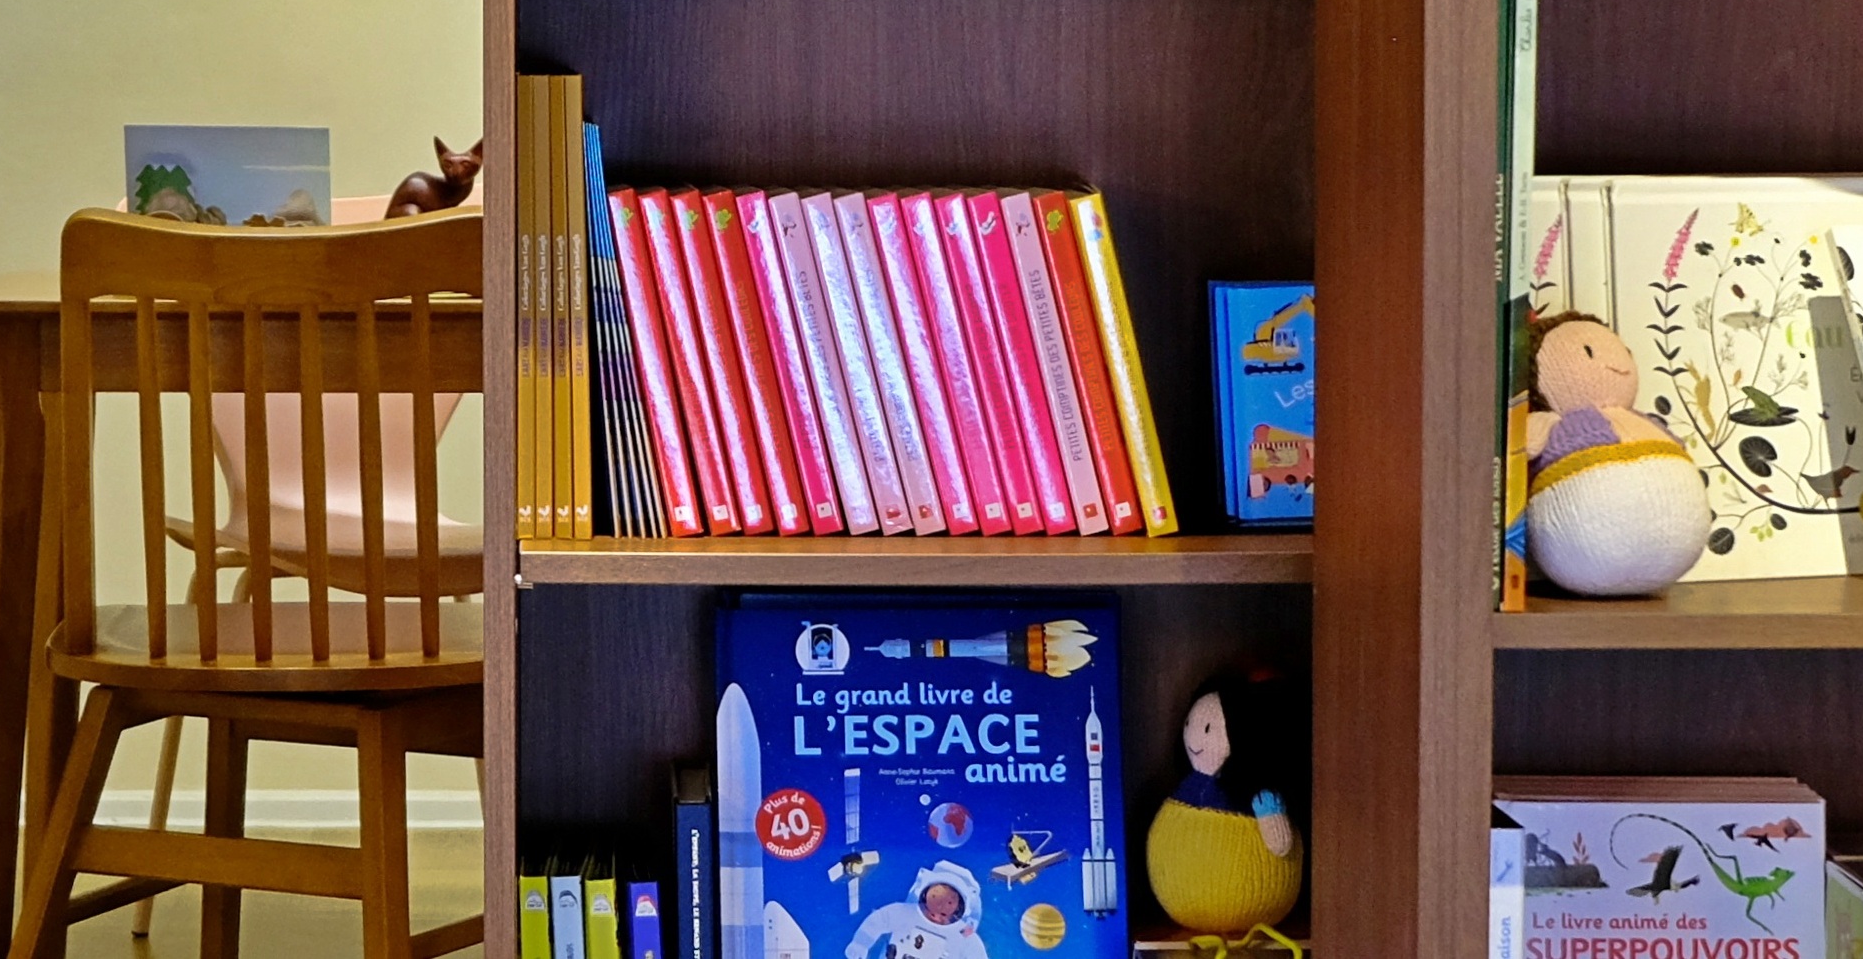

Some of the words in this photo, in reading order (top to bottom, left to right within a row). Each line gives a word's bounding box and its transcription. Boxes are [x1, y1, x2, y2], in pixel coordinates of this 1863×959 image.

[1028, 268, 1047, 303] BÊTES
[1036, 302, 1056, 342] PETITES
[1047, 342, 1061, 362] DES
[1052, 364, 1076, 421] COMPTINES
[1067, 422, 1084, 462] PETITES
[795, 682, 826, 706] Le
[836, 682, 916, 715] grand
[919, 682, 978, 706] livre
[982, 681, 1013, 705] de
[793, 713, 1041, 756] L'ESPACE
[964, 754, 1067, 784] animé
[762, 793, 789, 814] Plus
[790, 791, 806, 805] de
[770, 807, 811, 840] 40
[1531, 912, 1556, 930] Le
[1560, 912, 1604, 931] livre
[1608, 912, 1668, 931] animé
[1675, 912, 1707, 931] des
[1526, 937, 1800, 959] SUPERPOUVOIRS
